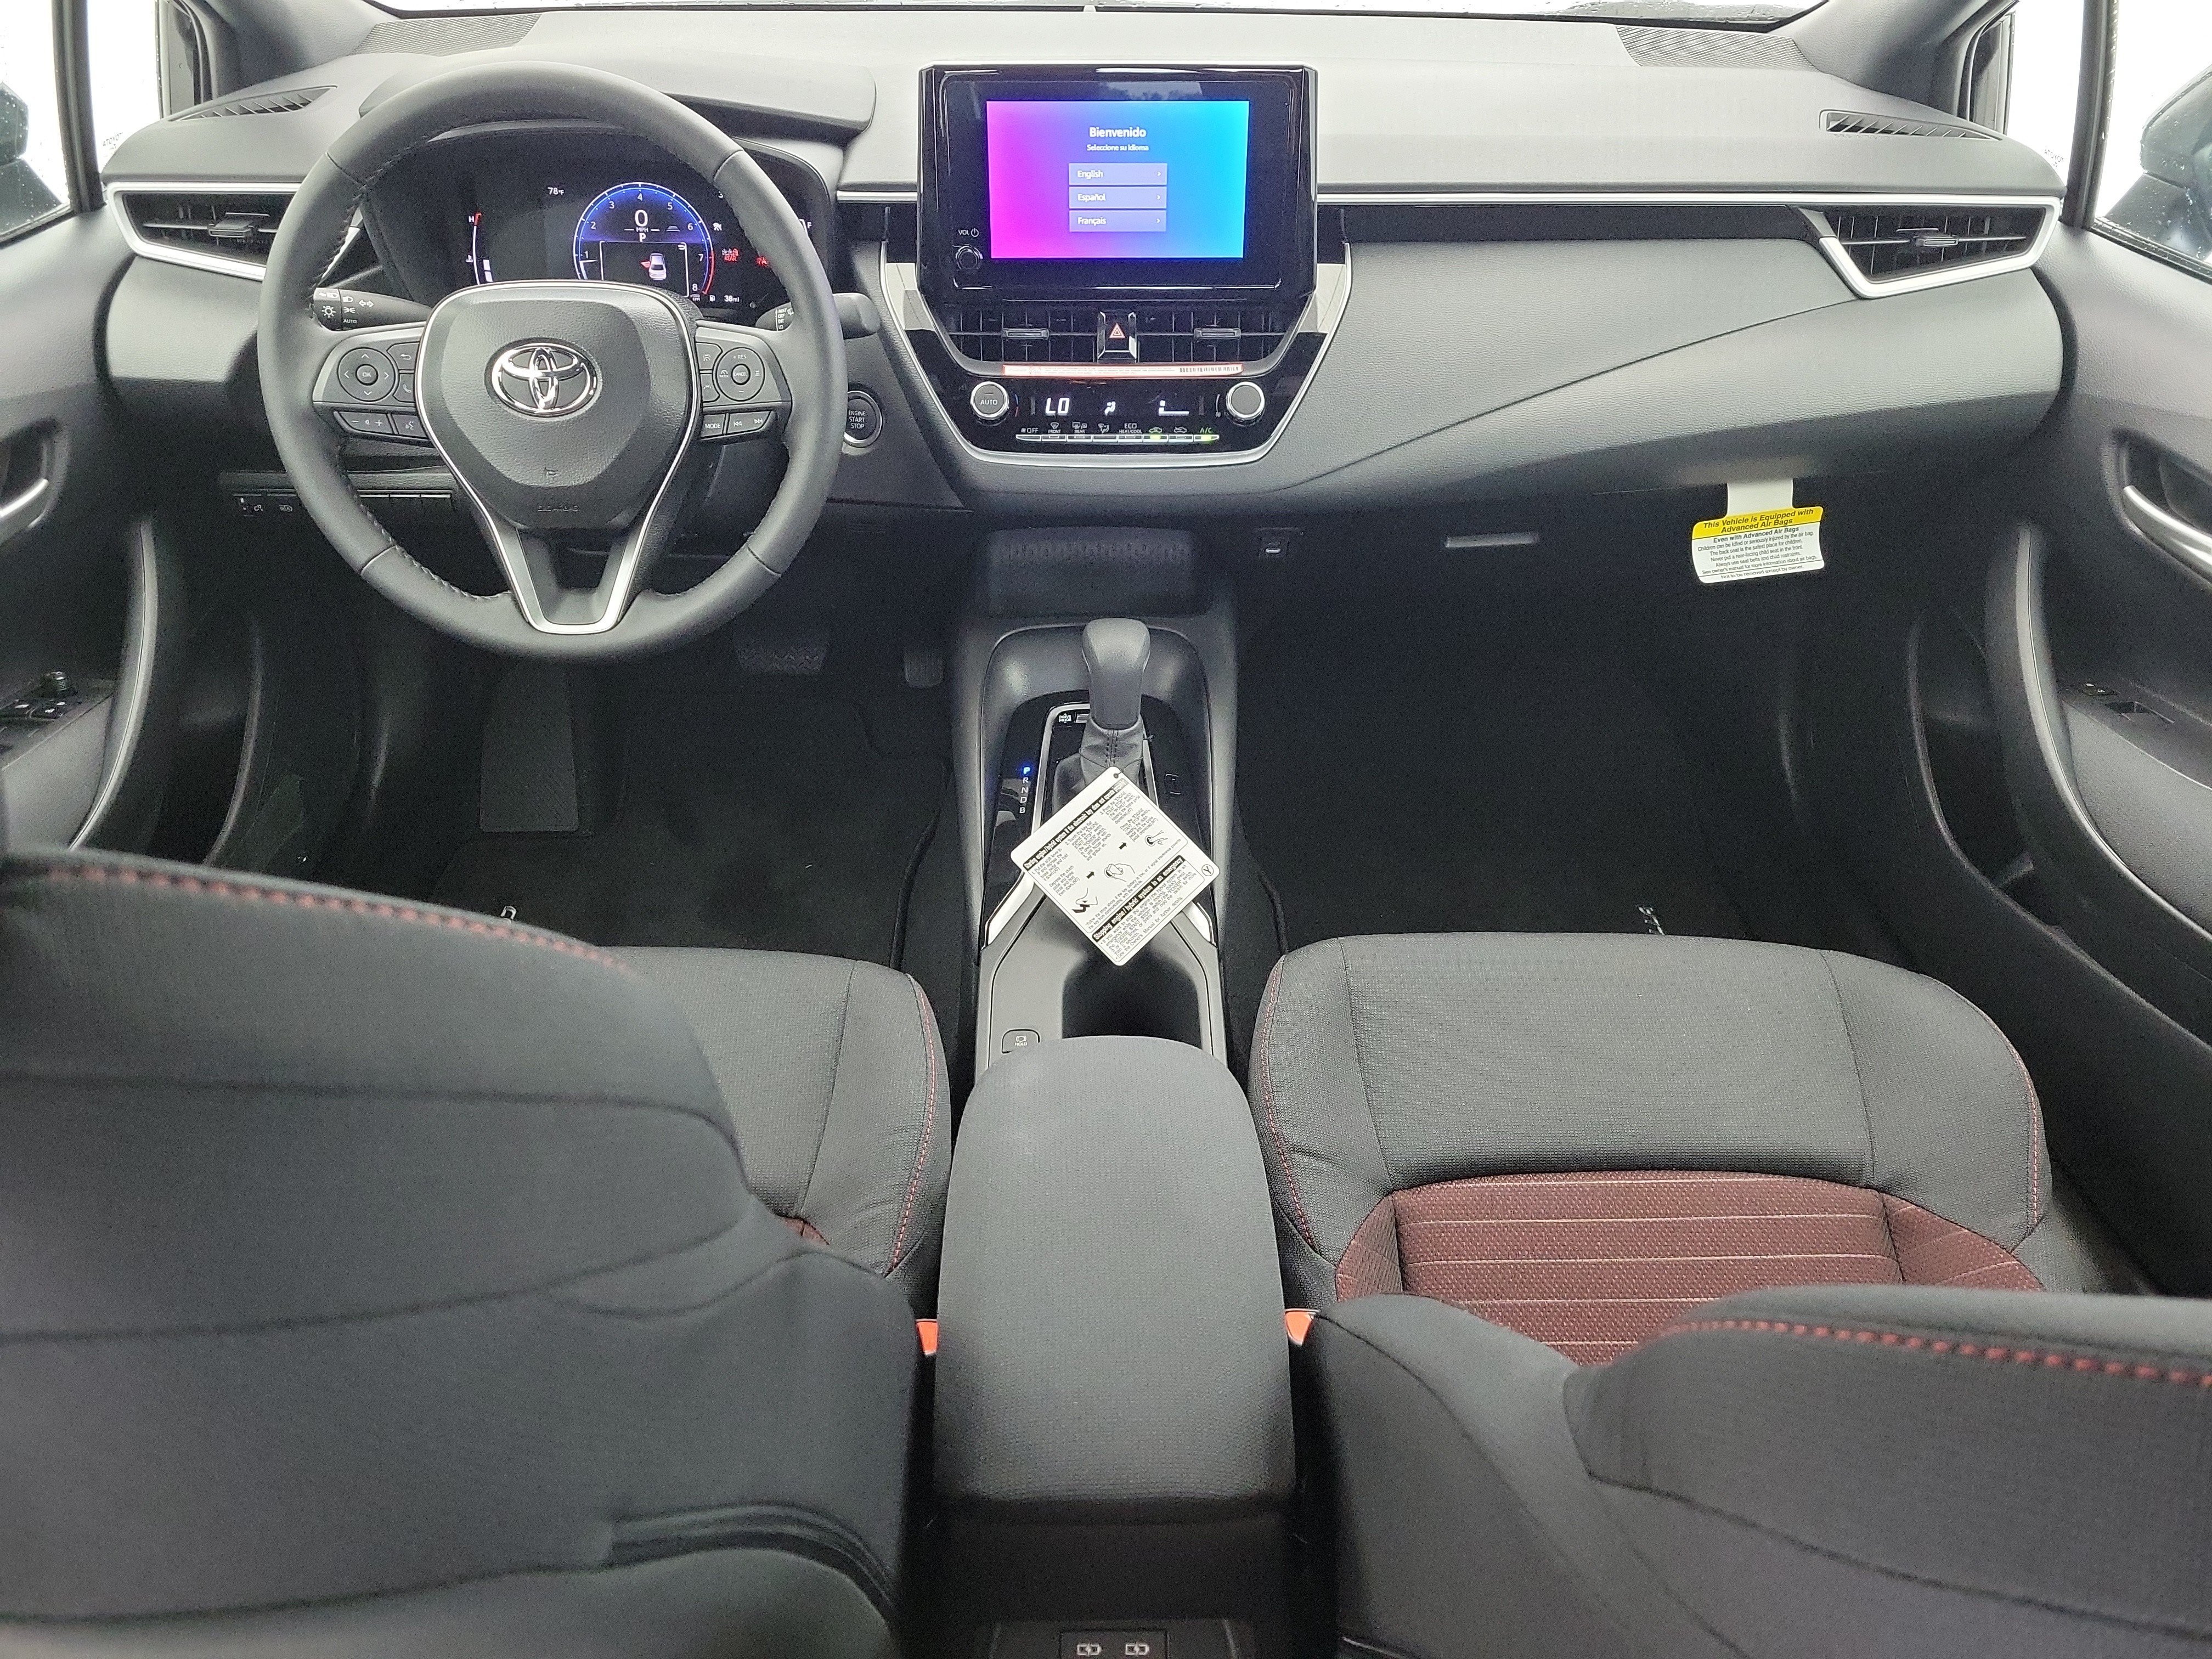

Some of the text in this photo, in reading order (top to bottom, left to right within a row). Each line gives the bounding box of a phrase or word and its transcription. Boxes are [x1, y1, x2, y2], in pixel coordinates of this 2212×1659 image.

[1089, 126, 1147, 137] Bienvenido
[1077, 170, 1104, 179] English
[637, 193, 643, 201] 4
[1077, 193, 1106, 202] Español
[609, 201, 614, 209] 3
[634, 210, 648, 227] 0
[1077, 217, 1107, 226] Français
[639, 233, 646, 242] P
[698, 253, 704, 262] 7
[1722, 516, 1748, 526] Vehicle
[1759, 510, 1796, 522] Equipped
[1720, 522, 1758, 533] Advanced
[1773, 517, 1793, 527] Bags
[1743, 530, 1772, 538] Advanced
[1023, 766, 1031, 775] P
[1203, 866, 1212, 874] Y
[1093, 922, 1113, 940] Stopping
[1125, 897, 1139, 911] hybrid
[1137, 884, 1153, 899] system
[1163, 857, 1183, 877] emergency
